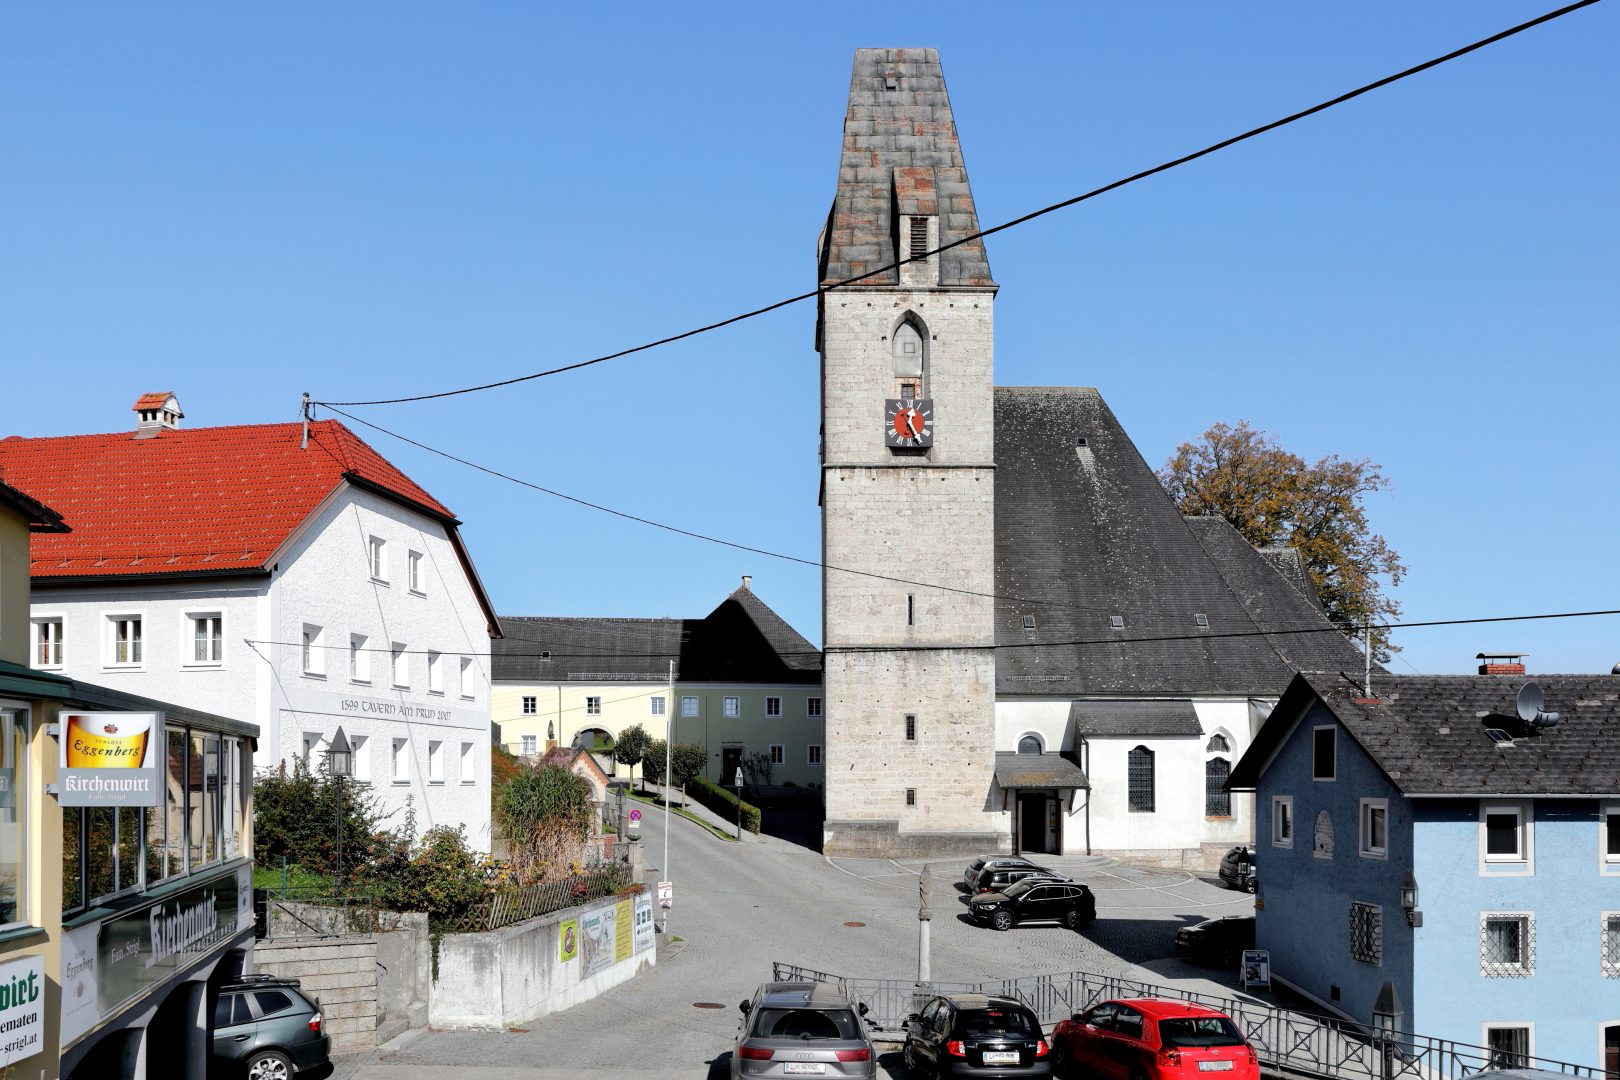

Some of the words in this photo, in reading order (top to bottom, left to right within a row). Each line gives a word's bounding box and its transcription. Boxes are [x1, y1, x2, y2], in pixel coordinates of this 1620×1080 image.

[341, 699, 359, 712] 1599
[399, 705, 414, 718] AM
[437, 710, 452, 721] 2007
[74, 739, 141, 757] Eggenberg
[65, 775, 150, 793] Kirchenwirt
[145, 888, 218, 969] Kirchenwirt
[110, 947, 125, 964] Fam.
